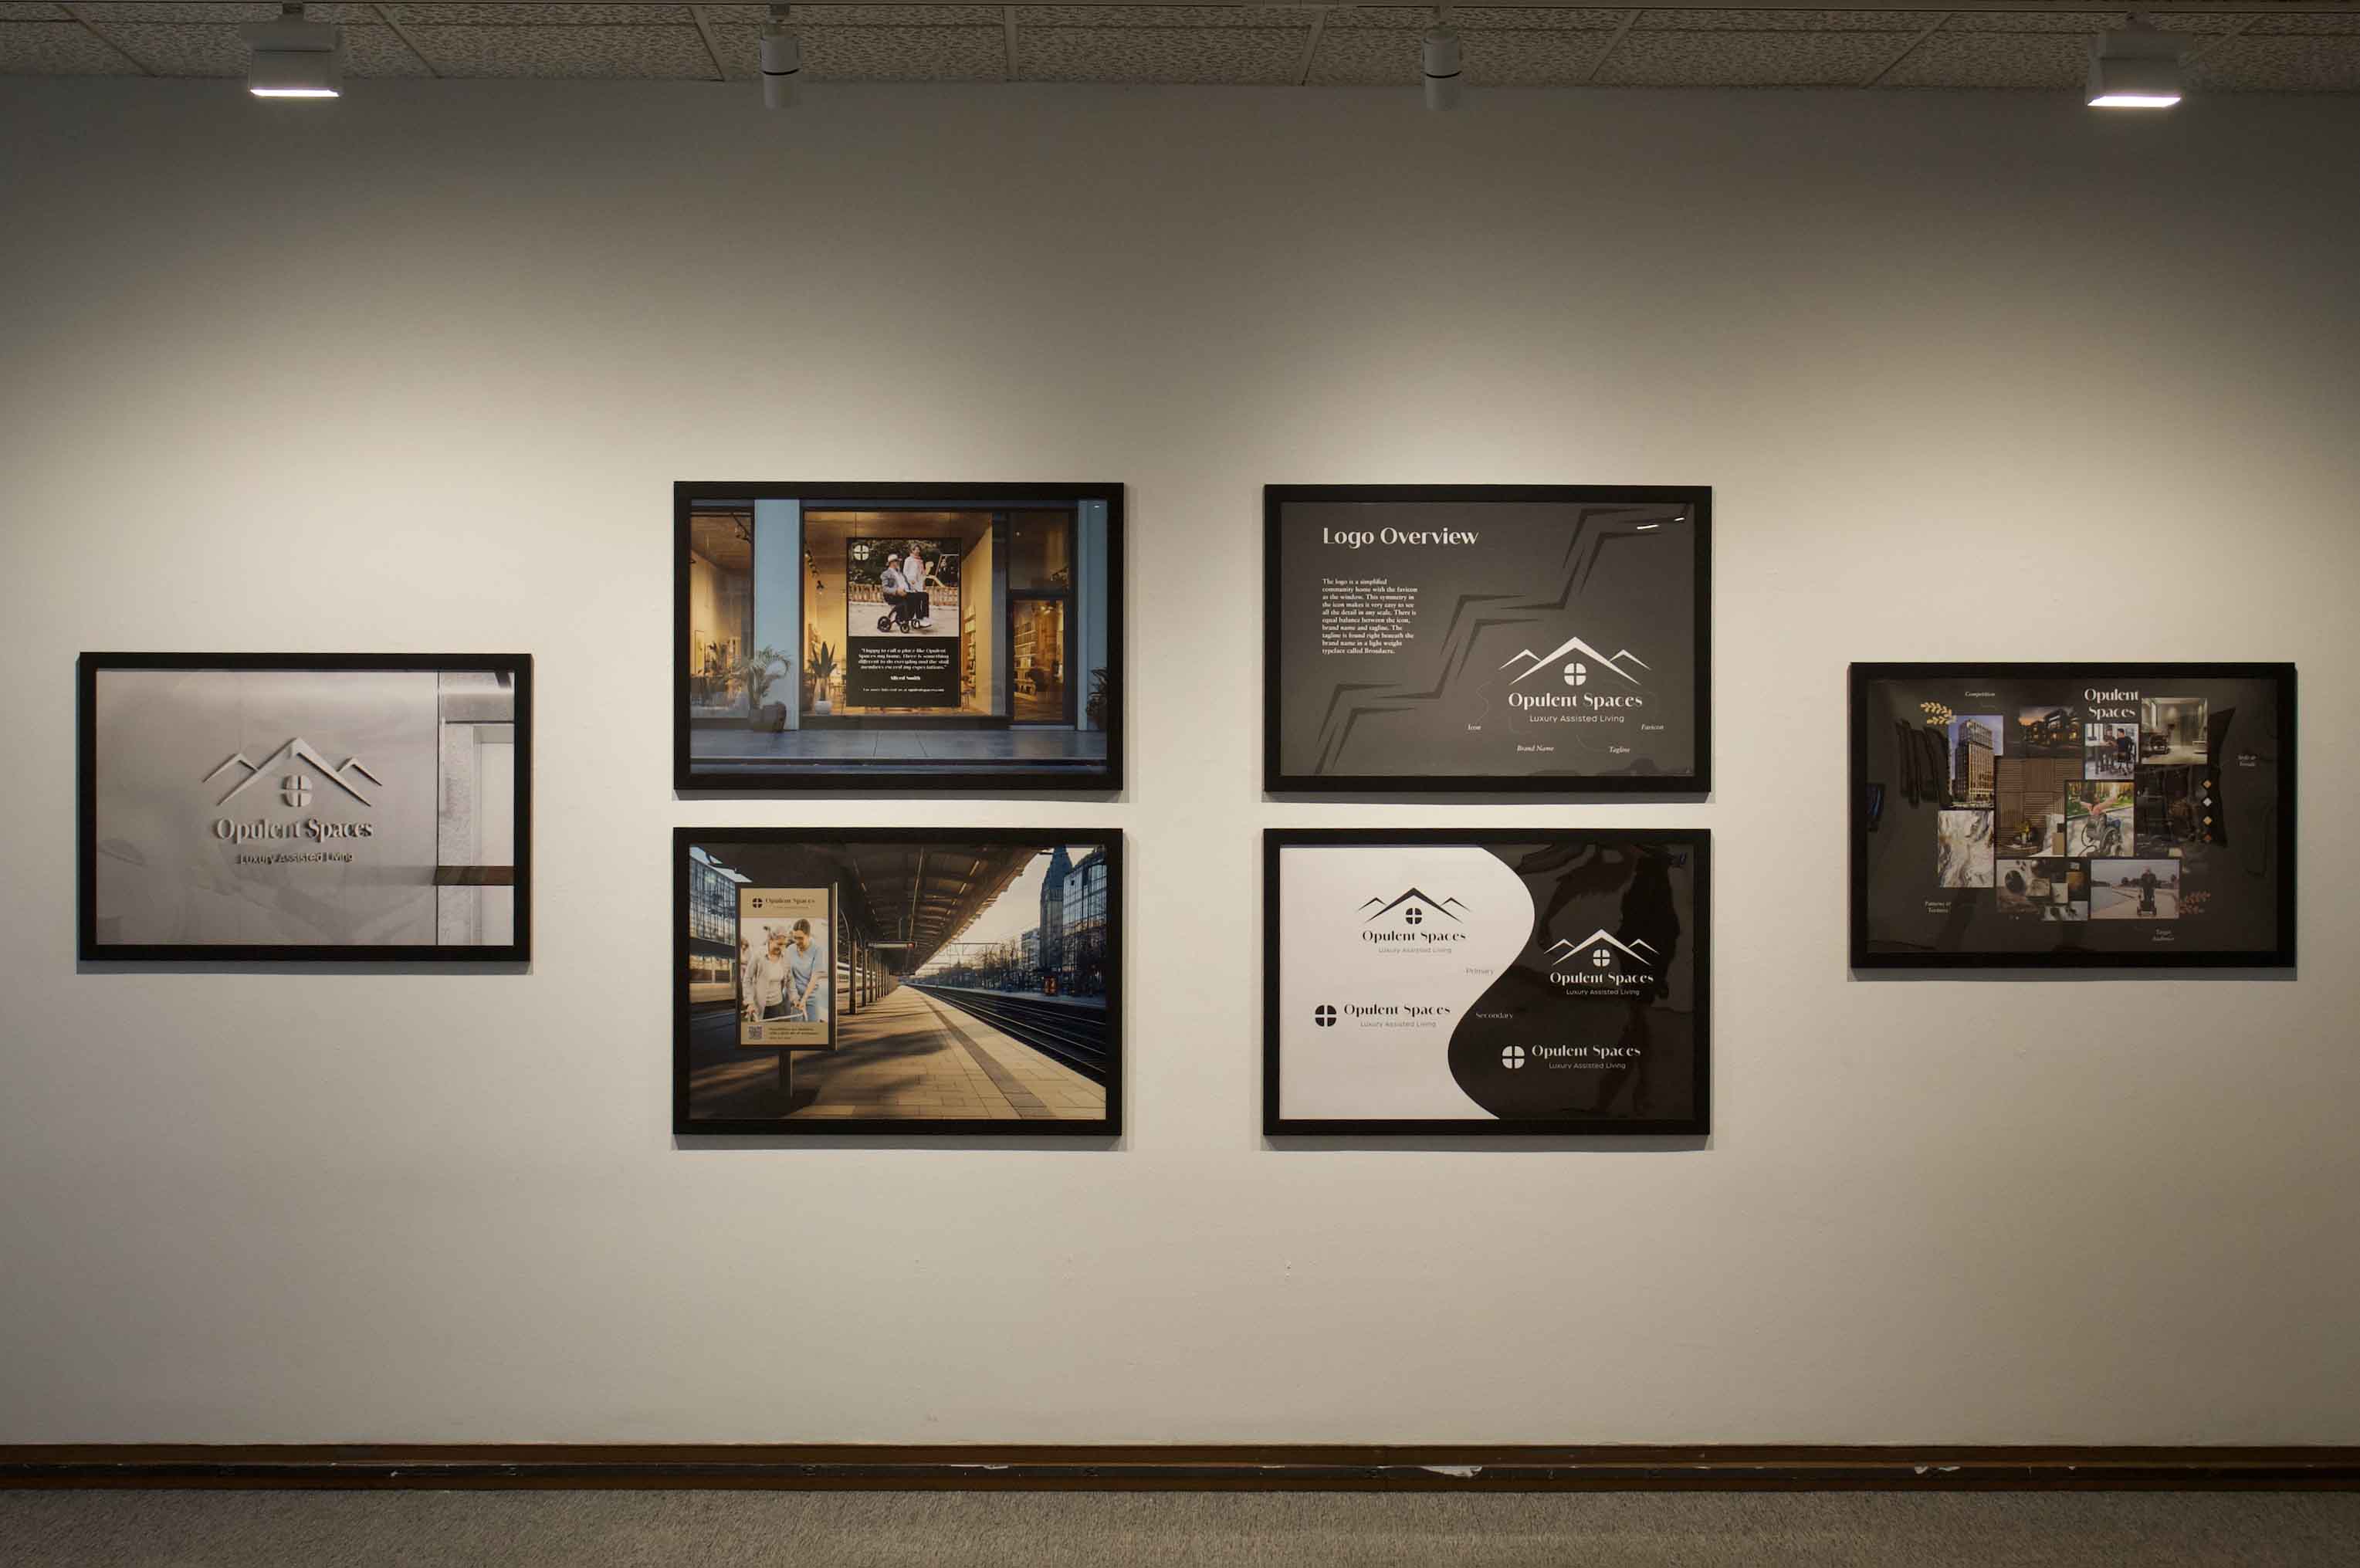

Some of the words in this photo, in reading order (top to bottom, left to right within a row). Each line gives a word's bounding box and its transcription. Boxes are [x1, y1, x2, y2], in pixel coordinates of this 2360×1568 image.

[1323, 527, 1375, 549] Logo
[1380, 527, 1479, 544] Overview
[1508, 693, 1578, 710] Opulent
[1583, 693, 1643, 710] Spaces
[2084, 688, 2139, 704] Opulent
[1529, 715, 1558, 723] Luxury
[1560, 715, 1597, 723] Assisted
[1600, 715, 1625, 723] Living
[2088, 706, 2136, 720] Spaces
[1609, 746, 1630, 754] Tagline
[215, 817, 300, 844] Opulent
[305, 817, 374, 843] Spaces
[239, 852, 273, 864] Luxury
[276, 852, 323, 863] Assisted
[326, 852, 354, 863] Living
[1362, 930, 1416, 943] Opulent
[1420, 930, 1467, 943] Spaces
[1549, 971, 1603, 986] Opulent
[1607, 971, 1654, 986] Spaces
[1343, 1004, 1400, 1018] Opulent
[1403, 1004, 1451, 1018] Spaces
[1532, 1045, 1587, 1059] Opulent
[1592, 1045, 1641, 1059] Spaces
